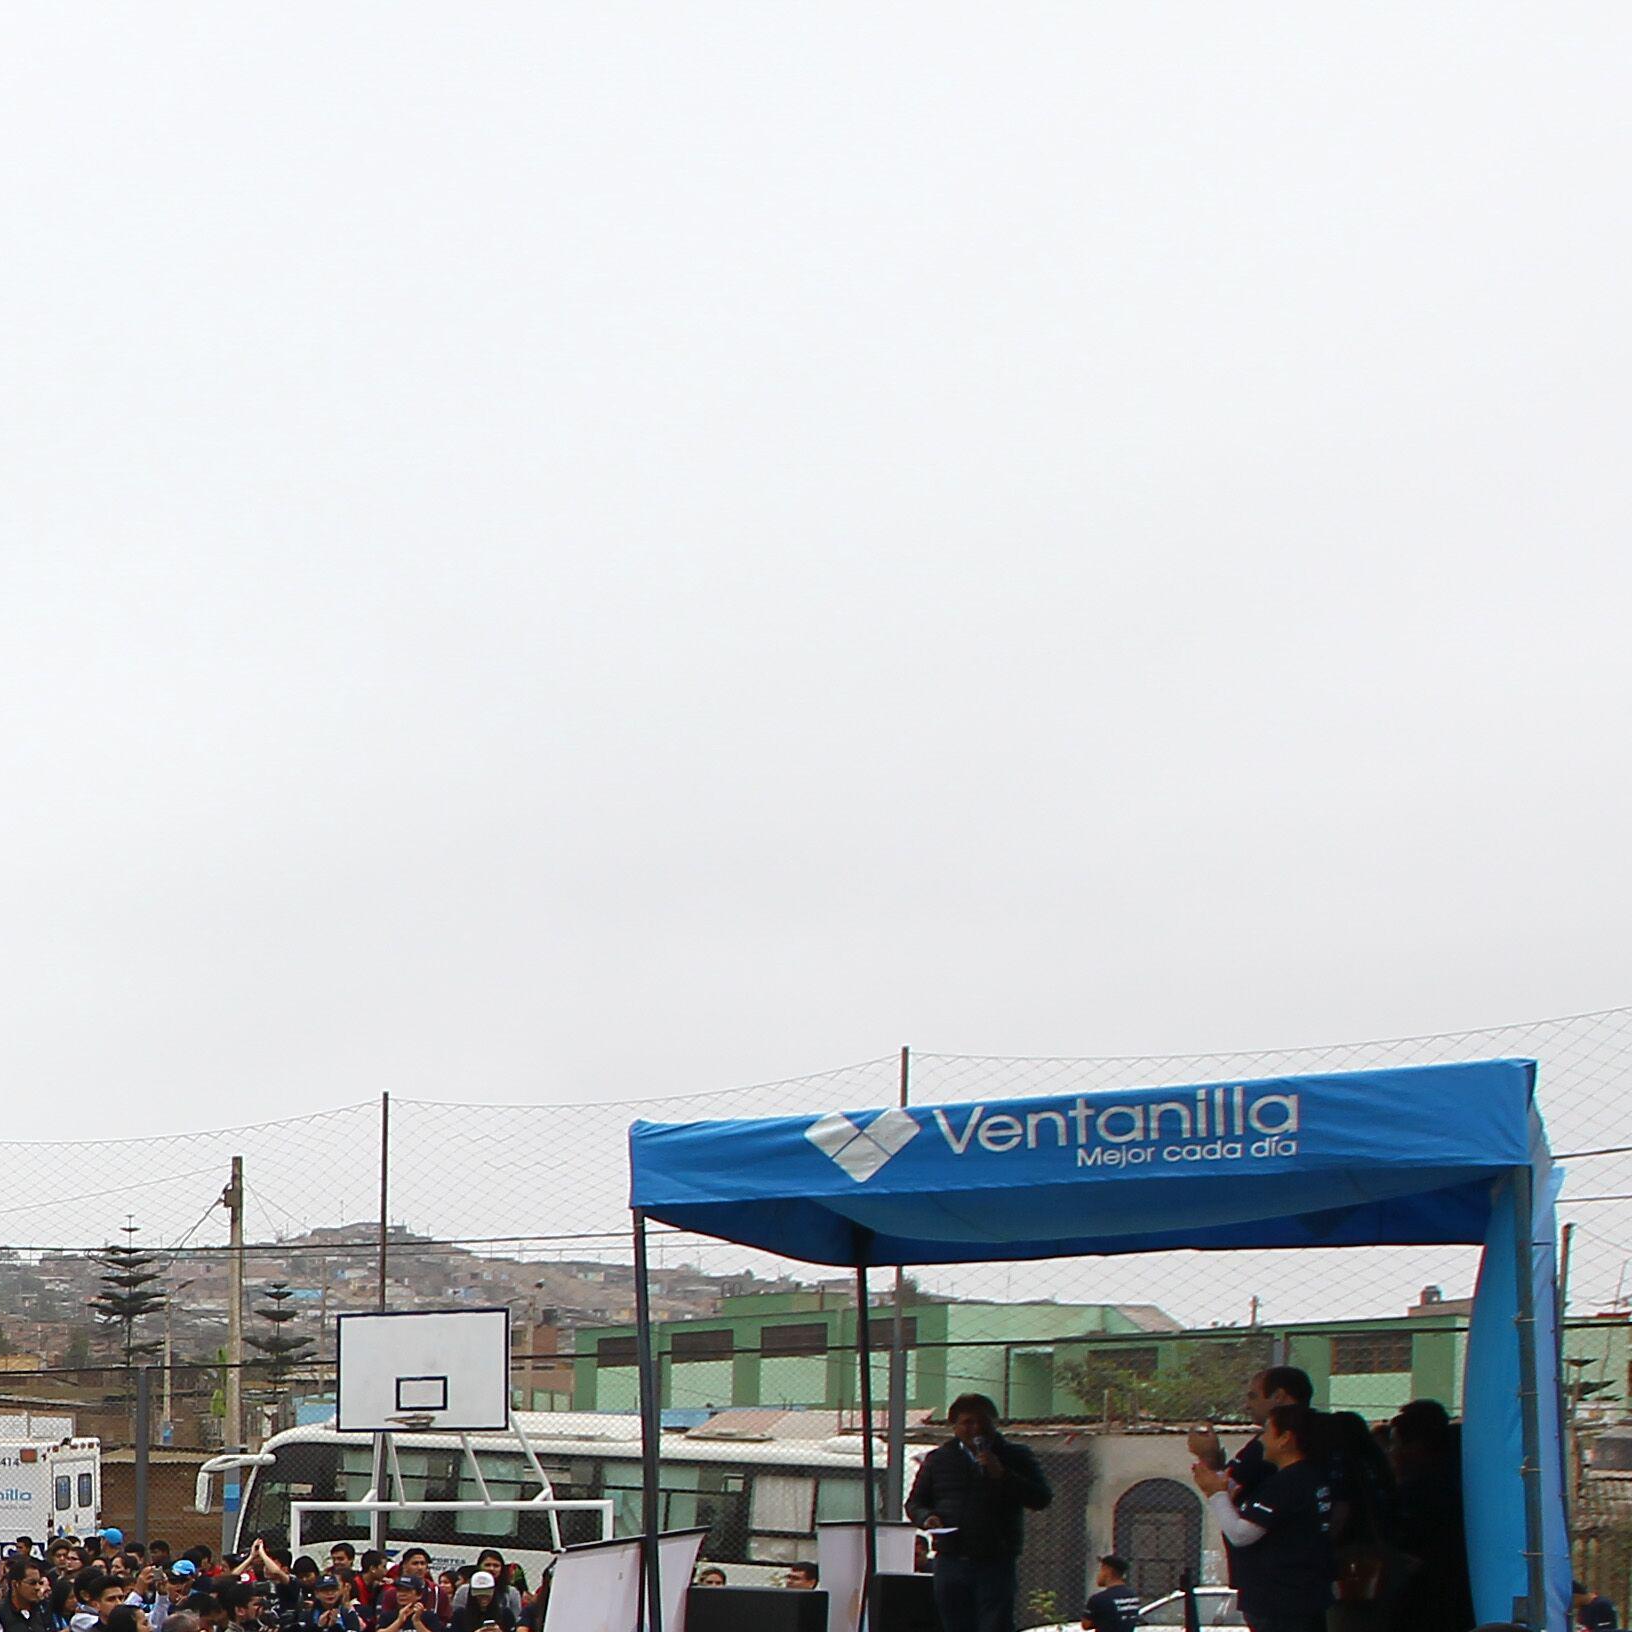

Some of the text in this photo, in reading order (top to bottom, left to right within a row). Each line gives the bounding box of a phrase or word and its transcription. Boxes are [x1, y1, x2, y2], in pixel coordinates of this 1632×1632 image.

[932, 1085, 1300, 1156] Ventanilla
[1076, 1136, 1299, 1169] Mejor cada día
